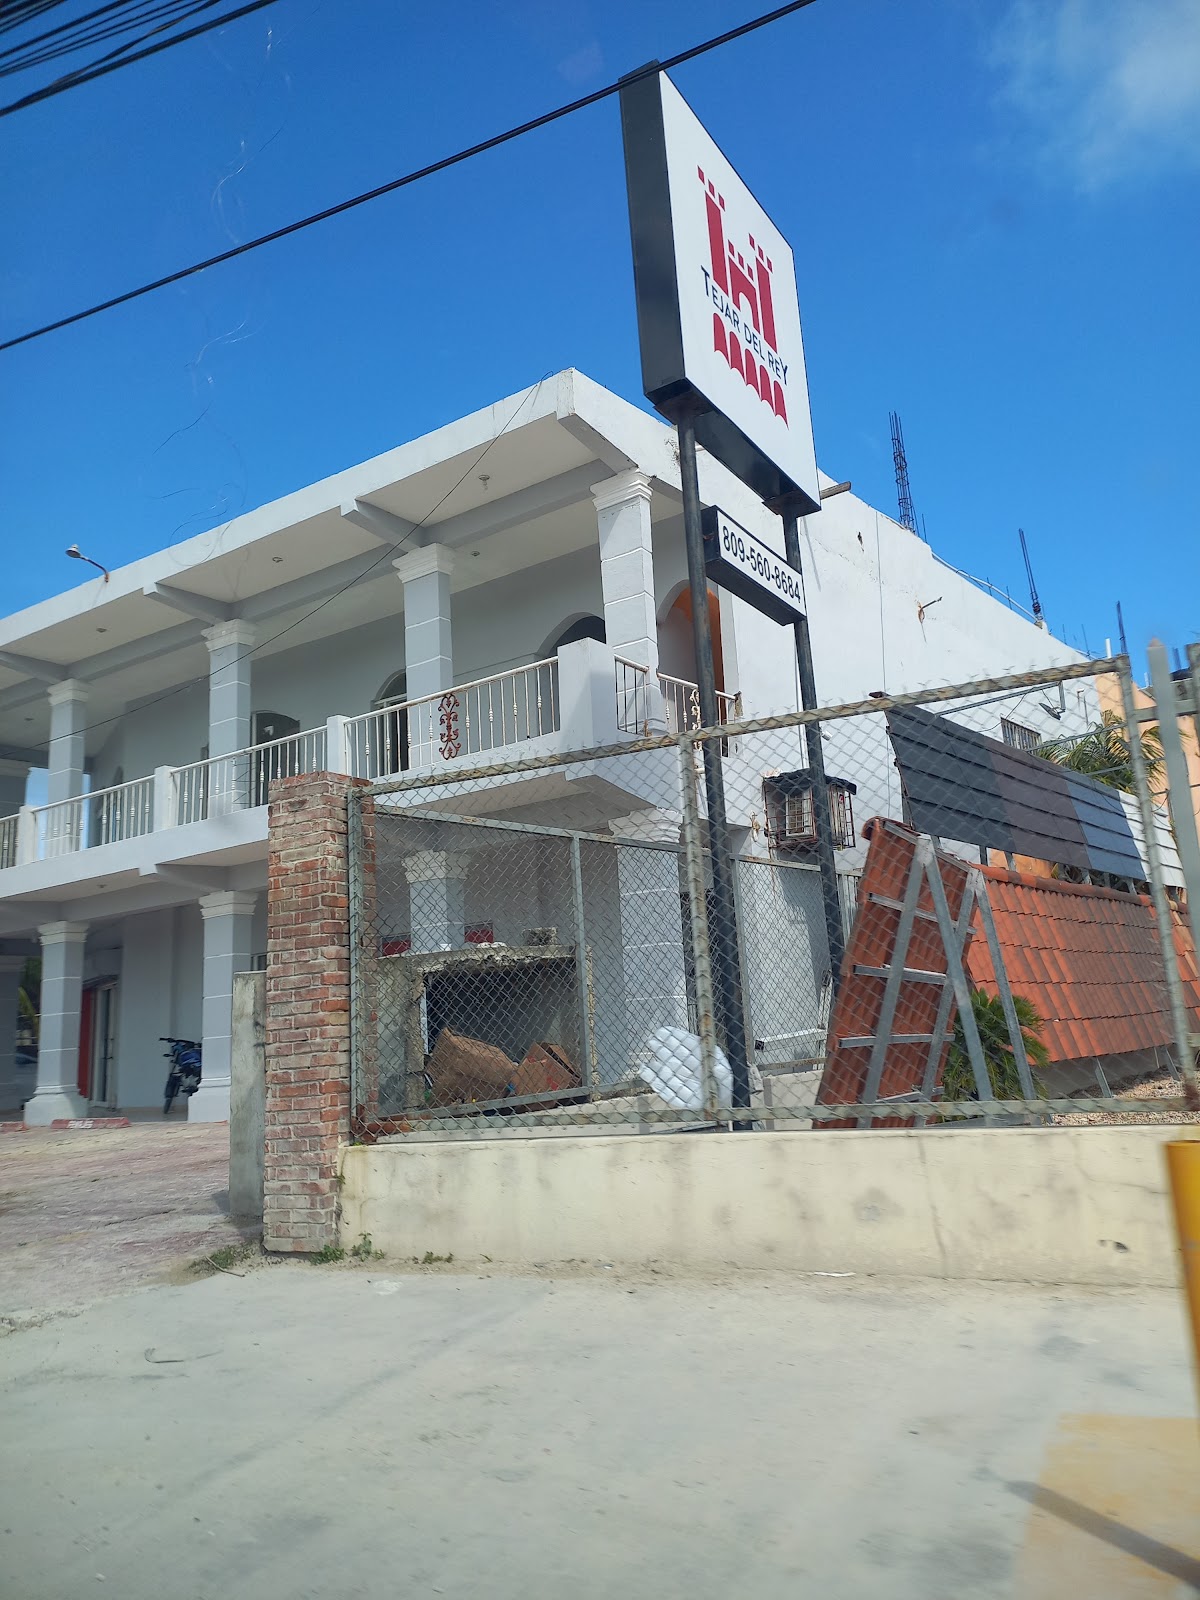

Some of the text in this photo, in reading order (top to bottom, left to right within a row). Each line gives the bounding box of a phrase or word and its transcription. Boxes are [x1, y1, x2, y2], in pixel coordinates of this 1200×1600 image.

[700, 265, 788, 386] TEJAR DEL REY
[722, 525, 801, 604] 809-560-8684
